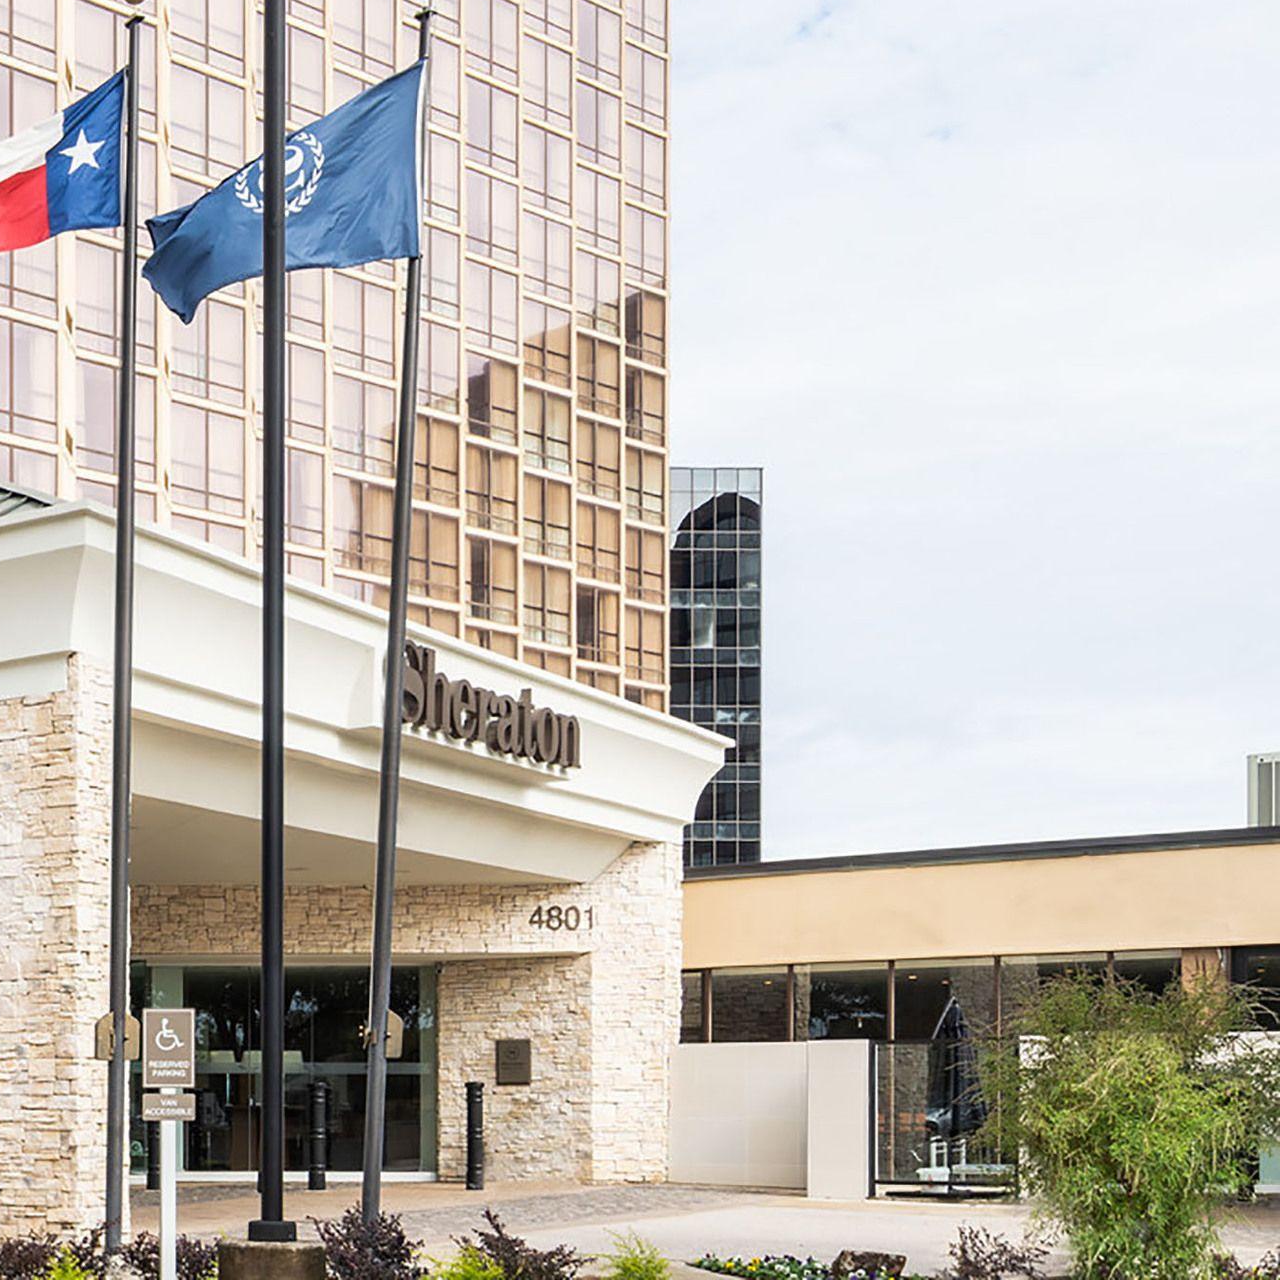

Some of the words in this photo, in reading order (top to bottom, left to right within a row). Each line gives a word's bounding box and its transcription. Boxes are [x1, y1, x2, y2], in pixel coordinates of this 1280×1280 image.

[402, 639, 581, 768] Sheraton
[529, 905, 593, 931] 4801
[148, 1060, 191, 1069] RESERVED
[152, 1069, 186, 1078] PARKING
[160, 1099, 178, 1107] VAN
[144, 1107, 193, 1116] ACCESSIBLE
